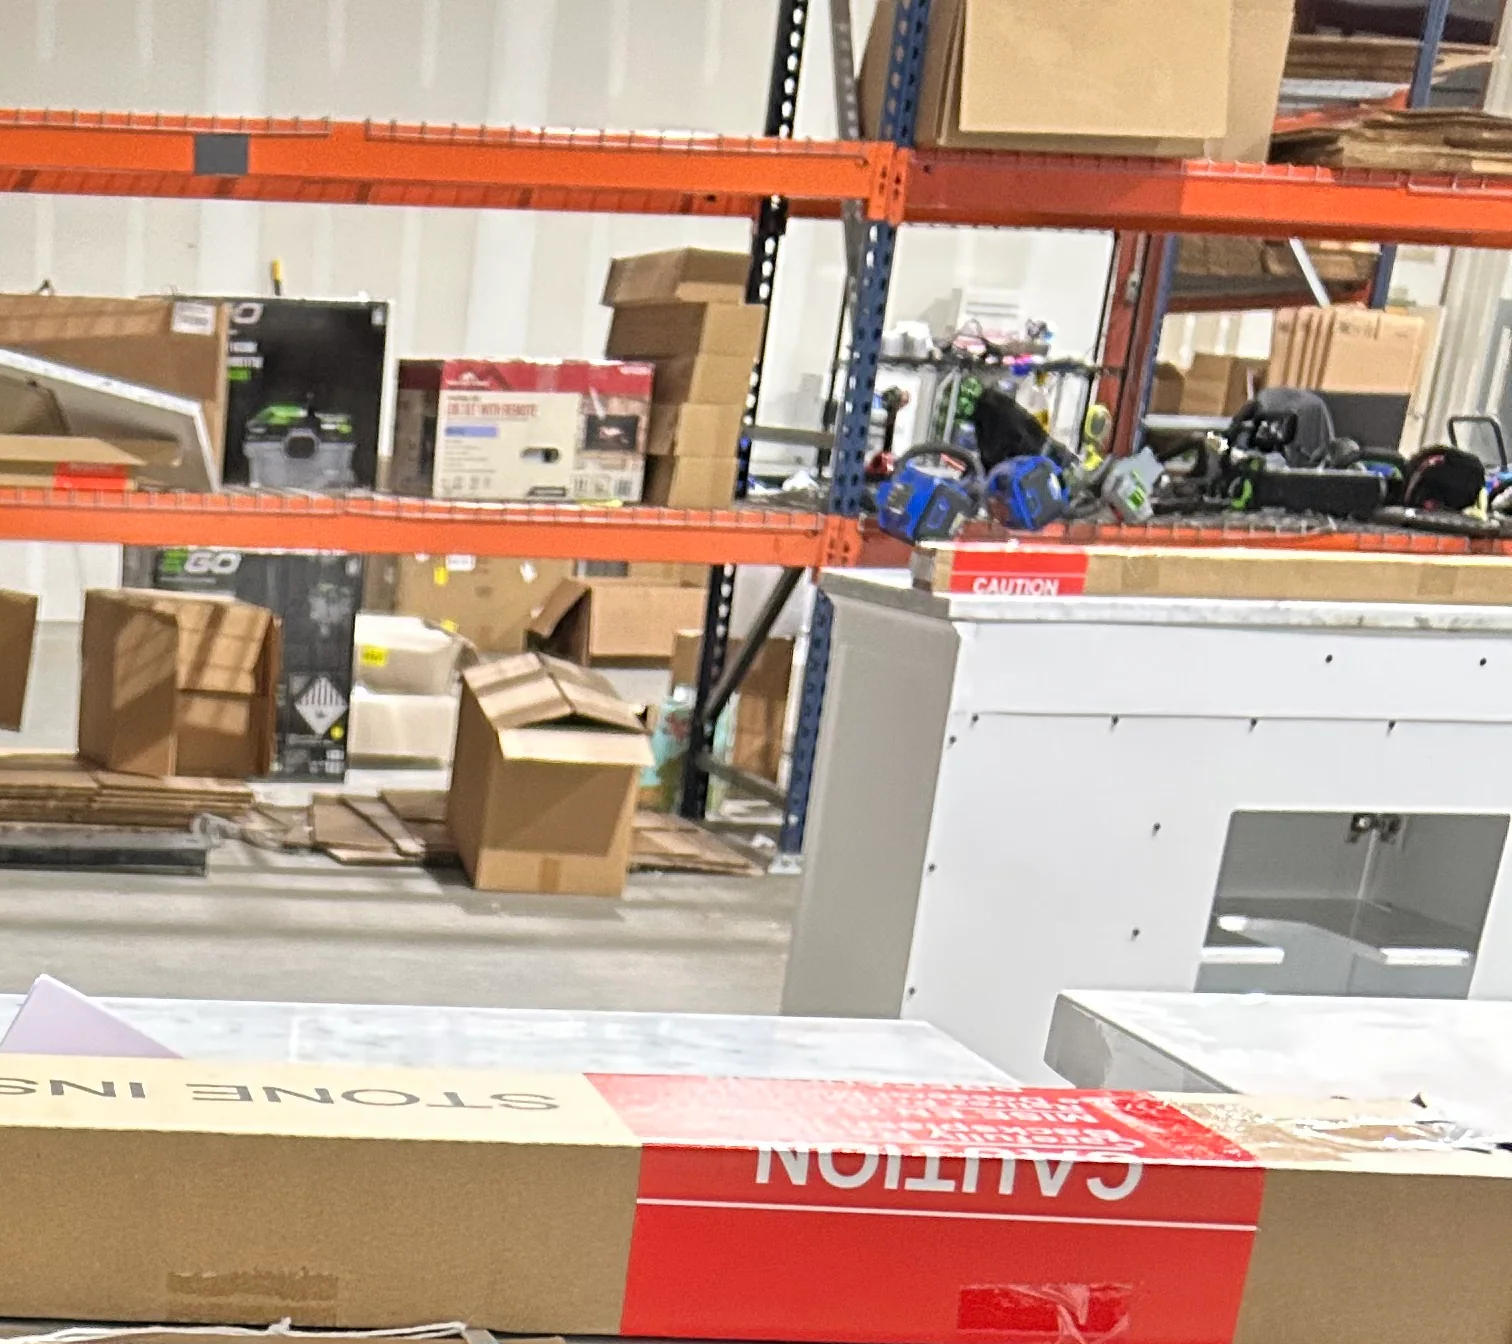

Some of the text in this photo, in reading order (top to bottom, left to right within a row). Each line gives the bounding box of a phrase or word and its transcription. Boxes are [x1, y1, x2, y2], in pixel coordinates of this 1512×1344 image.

[163, 551, 241, 575] EGO
[972, 577, 1060, 595] CAUTION
[185, 1083, 561, 1112] STONE
[754, 1141, 1144, 1201] CAUTION
